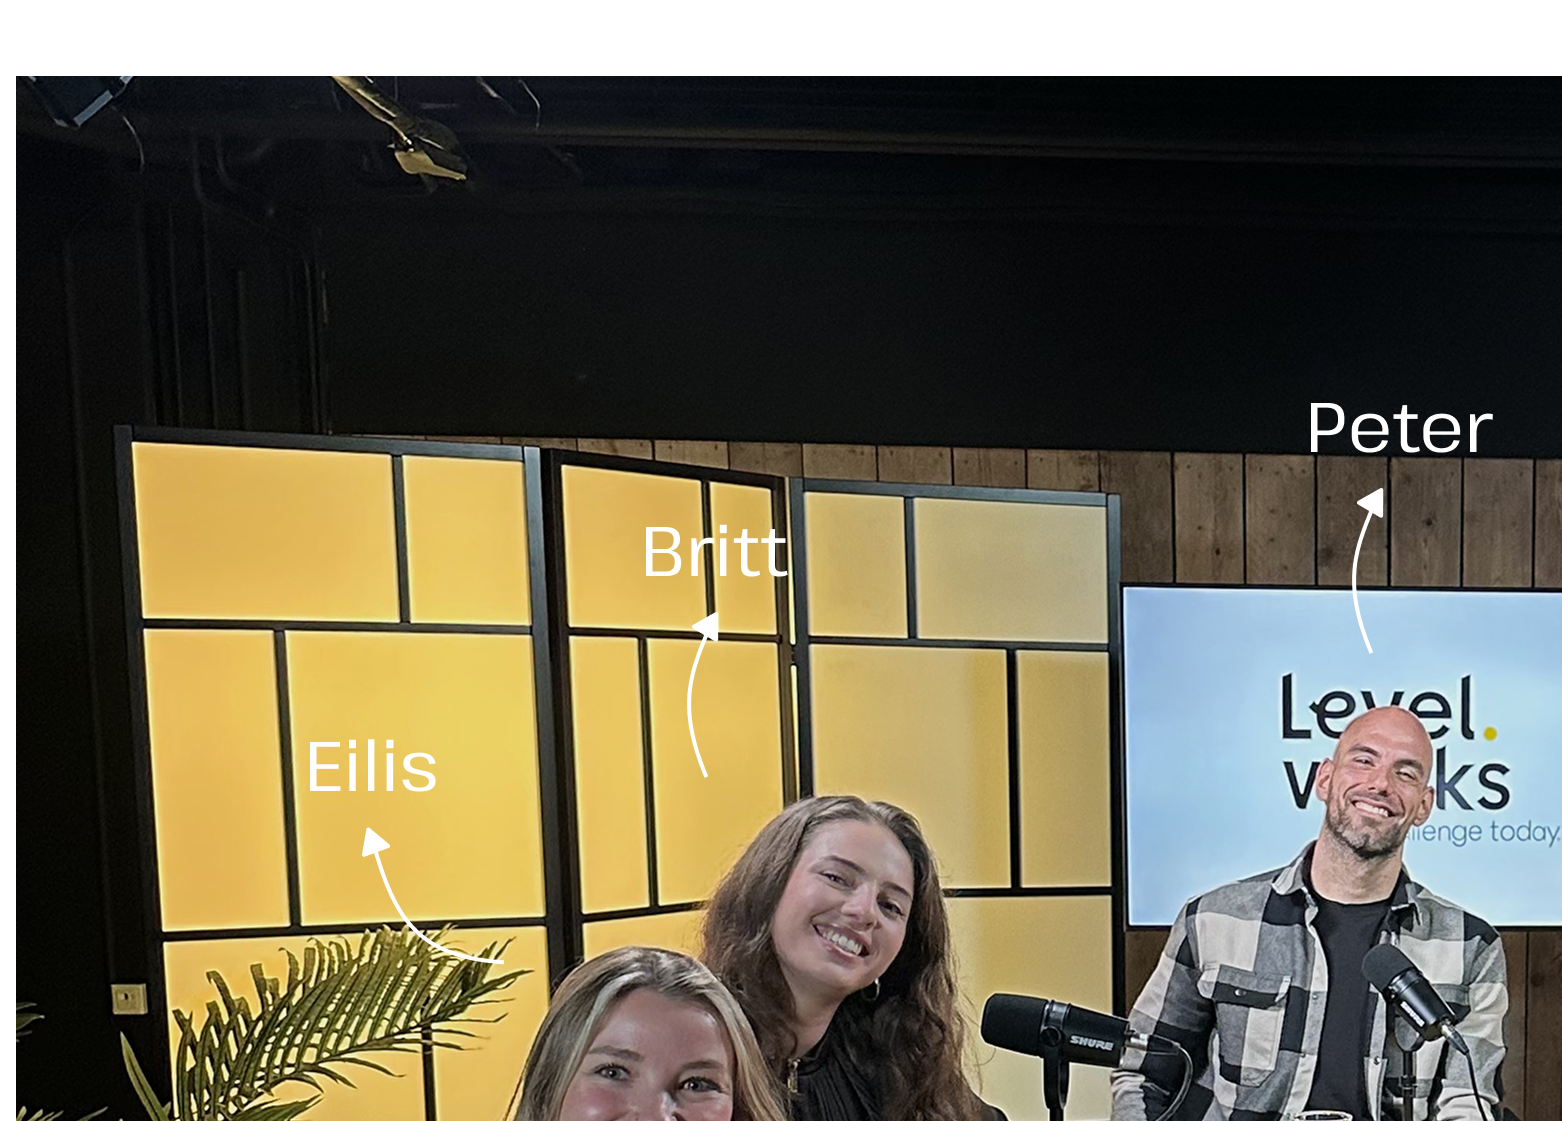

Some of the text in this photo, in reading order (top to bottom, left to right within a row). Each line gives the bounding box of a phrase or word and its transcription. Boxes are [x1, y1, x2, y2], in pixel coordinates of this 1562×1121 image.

[1283, 745, 1511, 812] wks
[1490, 820, 1561, 849] today.
[1070, 1035, 1114, 1051] SHURE
